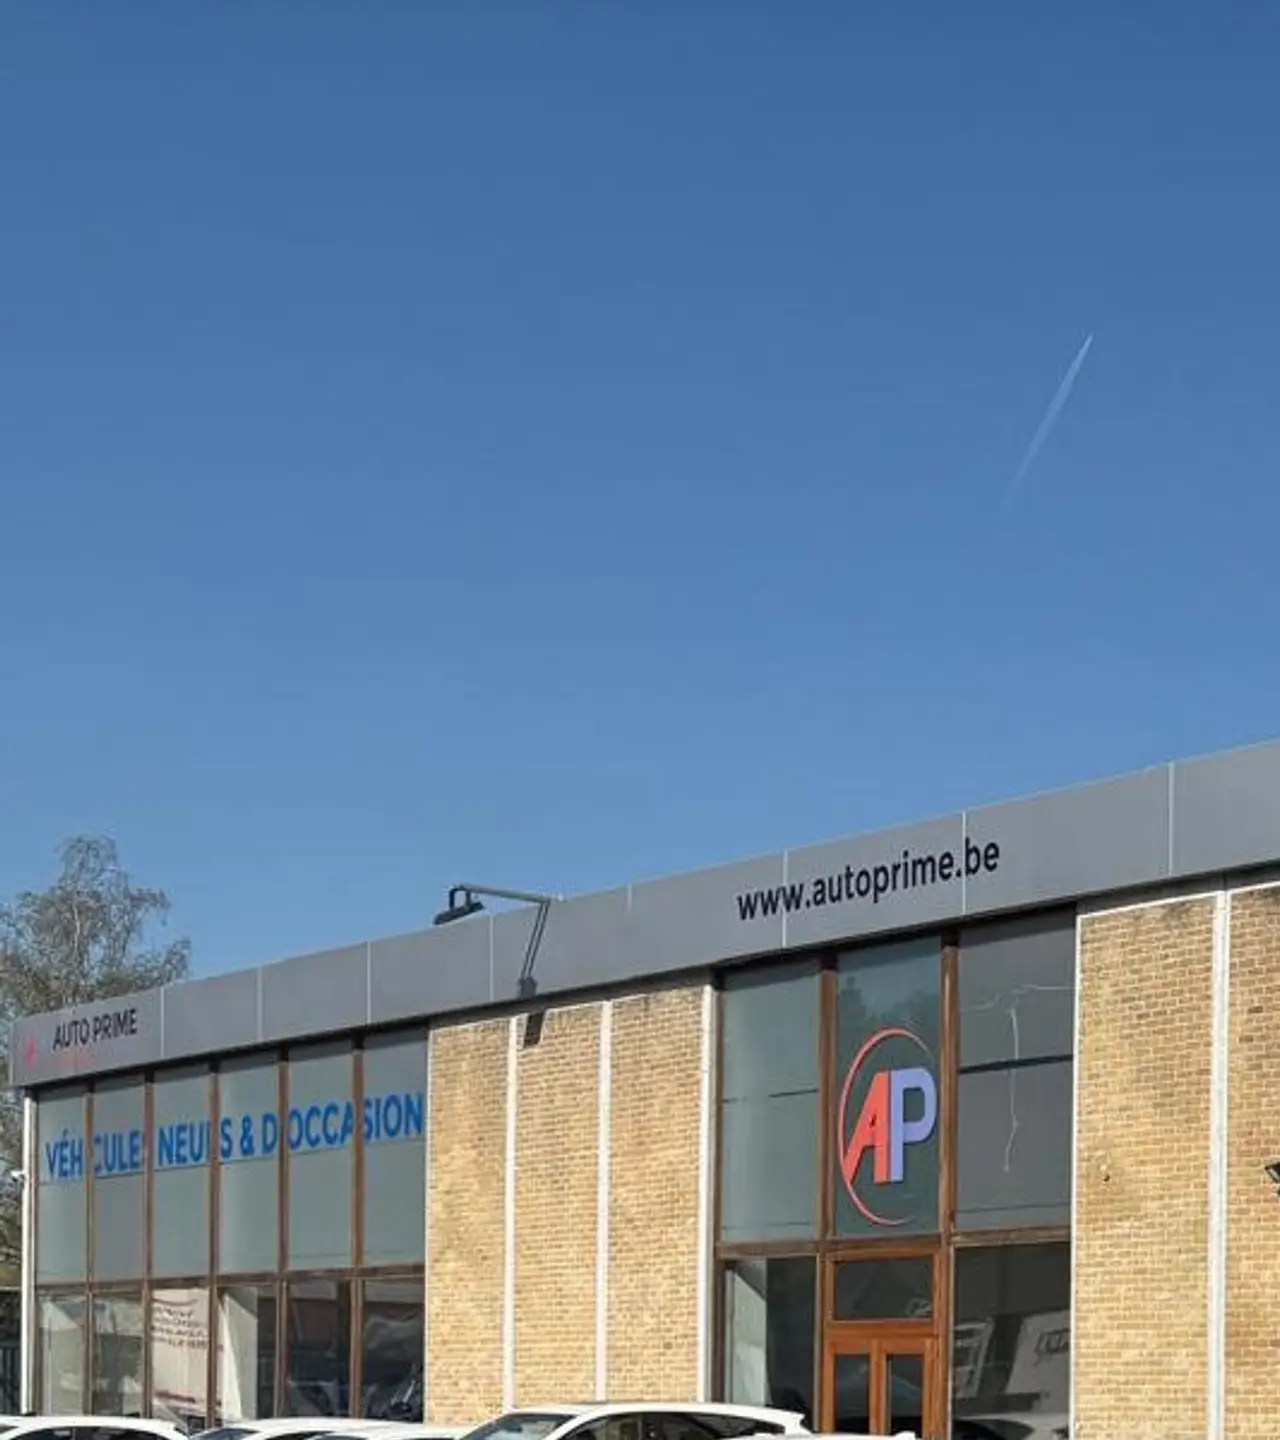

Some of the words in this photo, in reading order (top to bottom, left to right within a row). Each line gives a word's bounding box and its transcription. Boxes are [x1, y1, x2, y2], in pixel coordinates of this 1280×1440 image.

[737, 837, 1000, 920] www.autoprime.be
[52, 1017, 90, 1051] AUTO
[92, 1008, 138, 1043] PRIME
[45, 1127, 145, 1179] VÉHCULE
[158, 1117, 233, 1167] NEUS
[240, 1114, 255, 1157] &
[842, 1067, 937, 1184] AP
